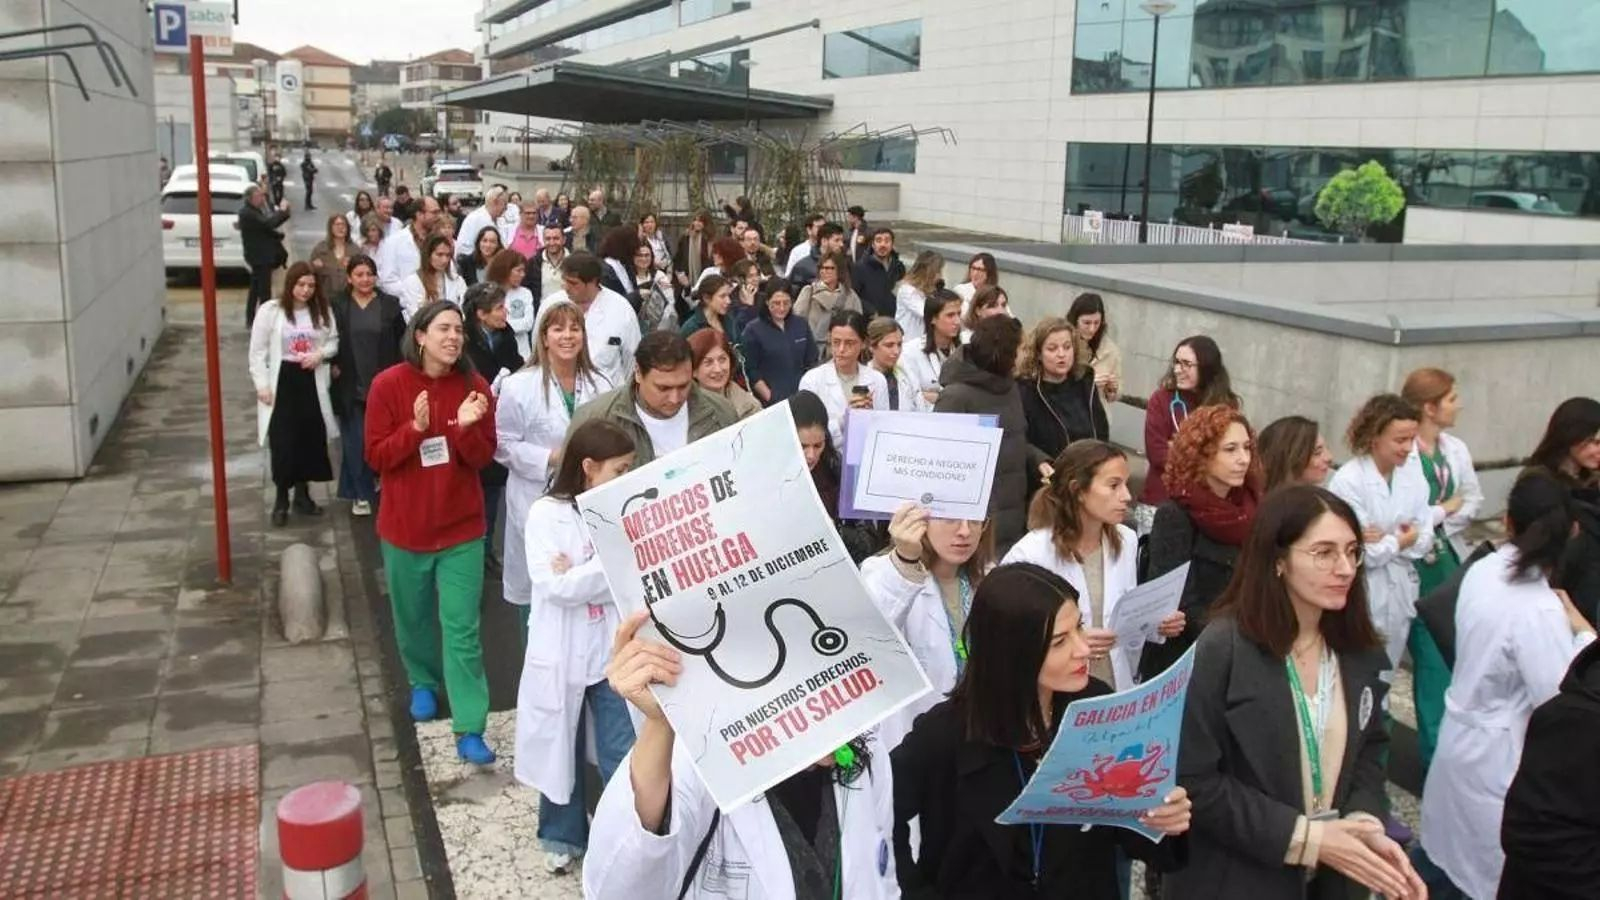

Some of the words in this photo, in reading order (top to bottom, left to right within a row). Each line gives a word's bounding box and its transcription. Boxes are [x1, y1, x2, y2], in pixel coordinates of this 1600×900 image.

[159, 9, 181, 40] P
[188, 9, 226, 23] saba
[886, 454, 927, 467] DERECHO
[935, 458, 978, 471] NEGOCIAR
[893, 466, 909, 477] MIS
[909, 469, 968, 482] CONDICIONES
[622, 483, 710, 543] MÉDICOS
[709, 469, 738, 503] DE
[633, 512, 718, 572] OURENSE
[641, 567, 673, 605] EN
[671, 531, 758, 591] HUELGA
[707, 587, 718, 600] 9
[718, 580, 734, 597] AL
[733, 574, 749, 590] 12
[748, 566, 766, 583] DE
[764, 538, 829, 576] DICIEMBRE
[720, 719, 747, 742] POR
[745, 684, 807, 728] NUESTROS
[806, 652, 872, 692] DERECHOS.
[729, 725, 781, 765] POR
[774, 706, 809, 739] TU
[805, 667, 884, 722] SALUD.
[1074, 701, 1137, 727] GALICIA
[1140, 690, 1159, 713] EN
